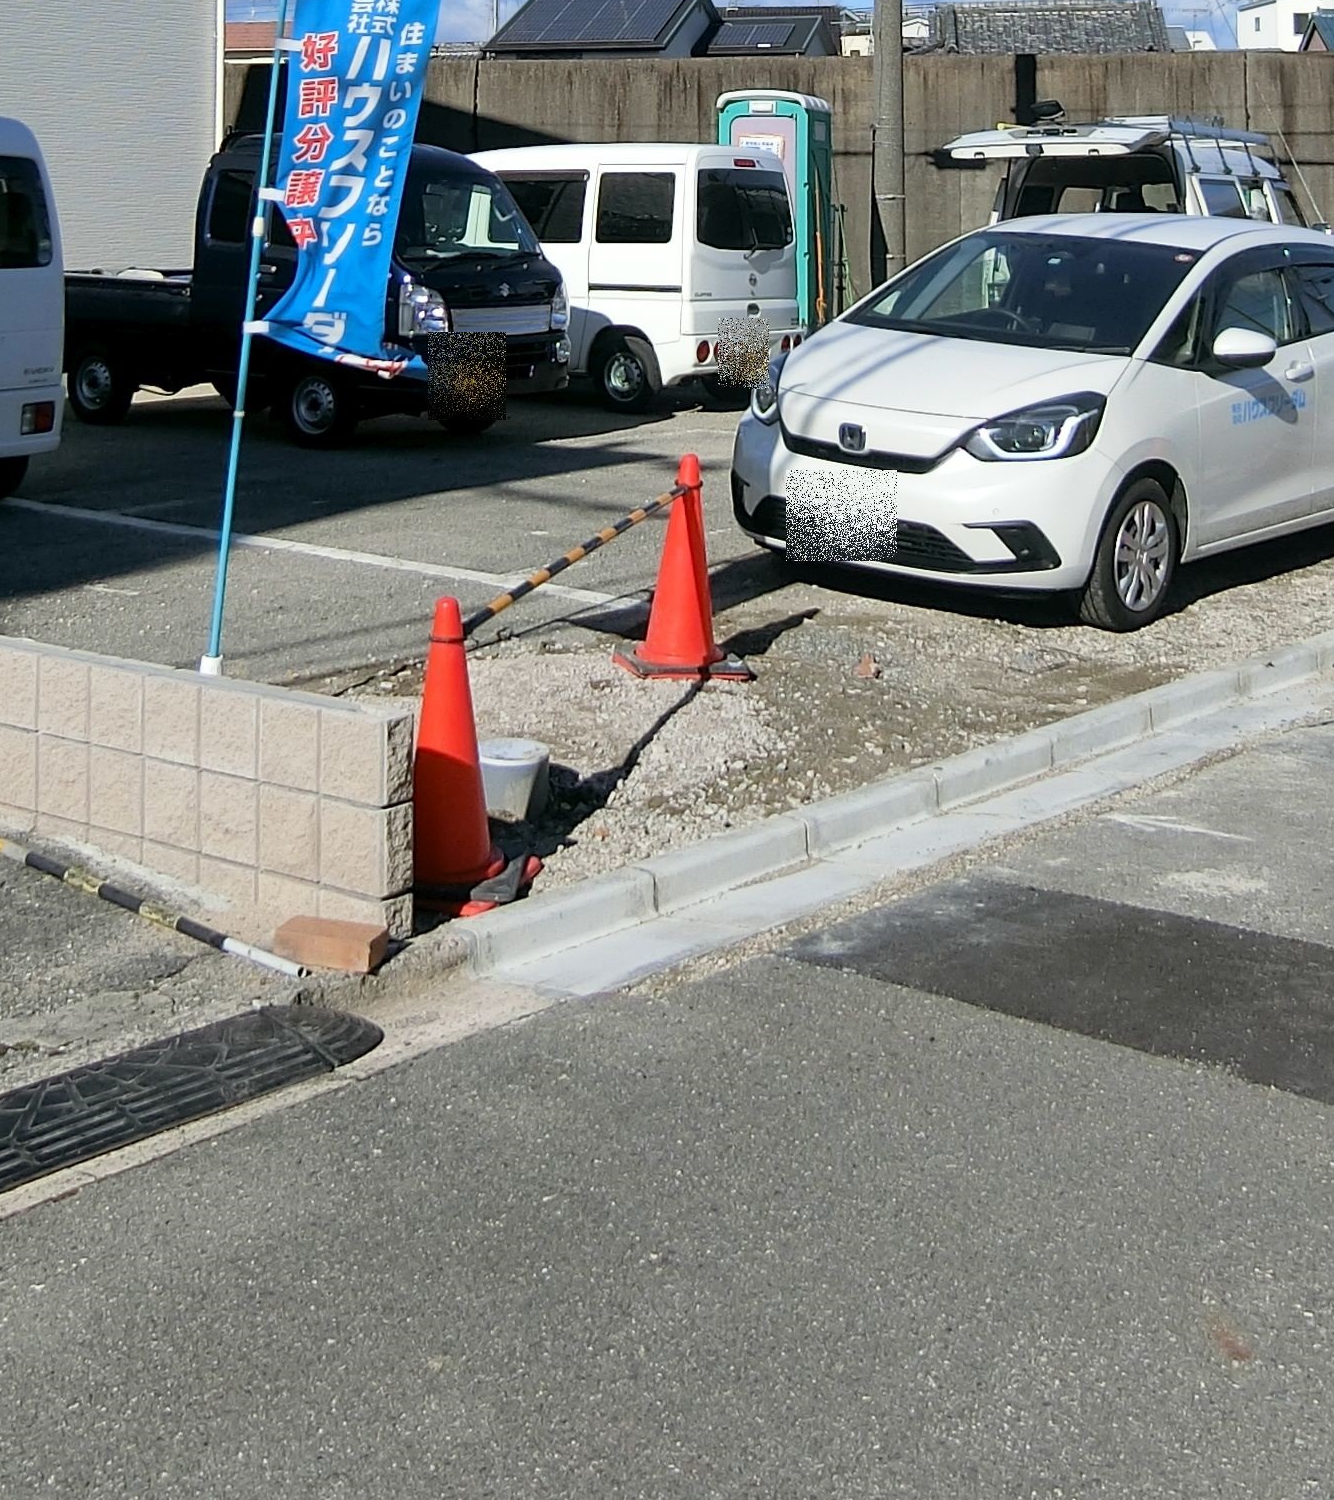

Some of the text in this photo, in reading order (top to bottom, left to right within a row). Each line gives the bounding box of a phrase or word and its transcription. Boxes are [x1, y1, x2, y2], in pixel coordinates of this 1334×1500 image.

[284, 30, 340, 251] 好評分譲中
[361, 21, 426, 247] 住まいのことなら
